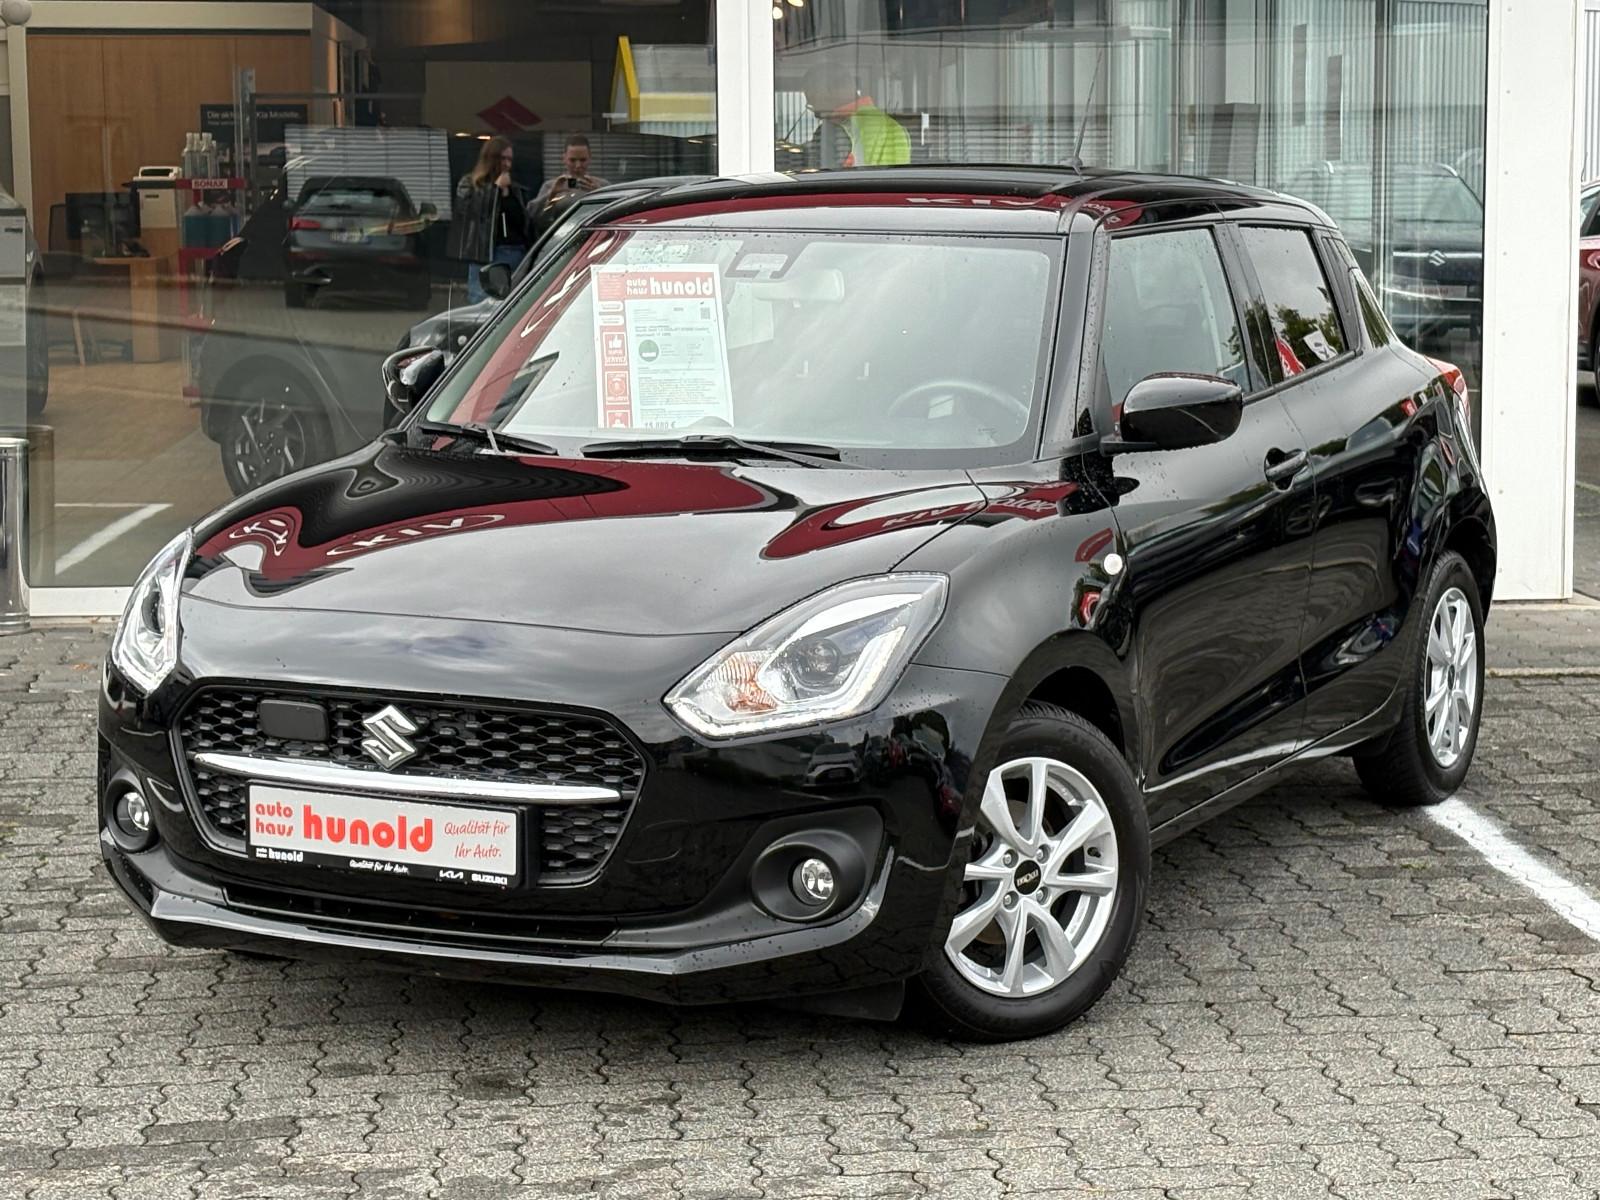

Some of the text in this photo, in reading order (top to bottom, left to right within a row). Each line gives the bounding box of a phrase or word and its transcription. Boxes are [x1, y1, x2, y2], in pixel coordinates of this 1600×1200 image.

[626, 279, 648, 288] auto
[626, 287, 648, 296] haus
[649, 277, 713, 297] hunold
[255, 802, 293, 818] auto
[255, 818, 294, 837] haus
[303, 804, 433, 853] hunold
[444, 819, 510, 837] Qualität für
[268, 847, 304, 862] hunold
[455, 842, 502, 859] Ihr Auto.
[471, 873, 508, 885] SUZUKI
